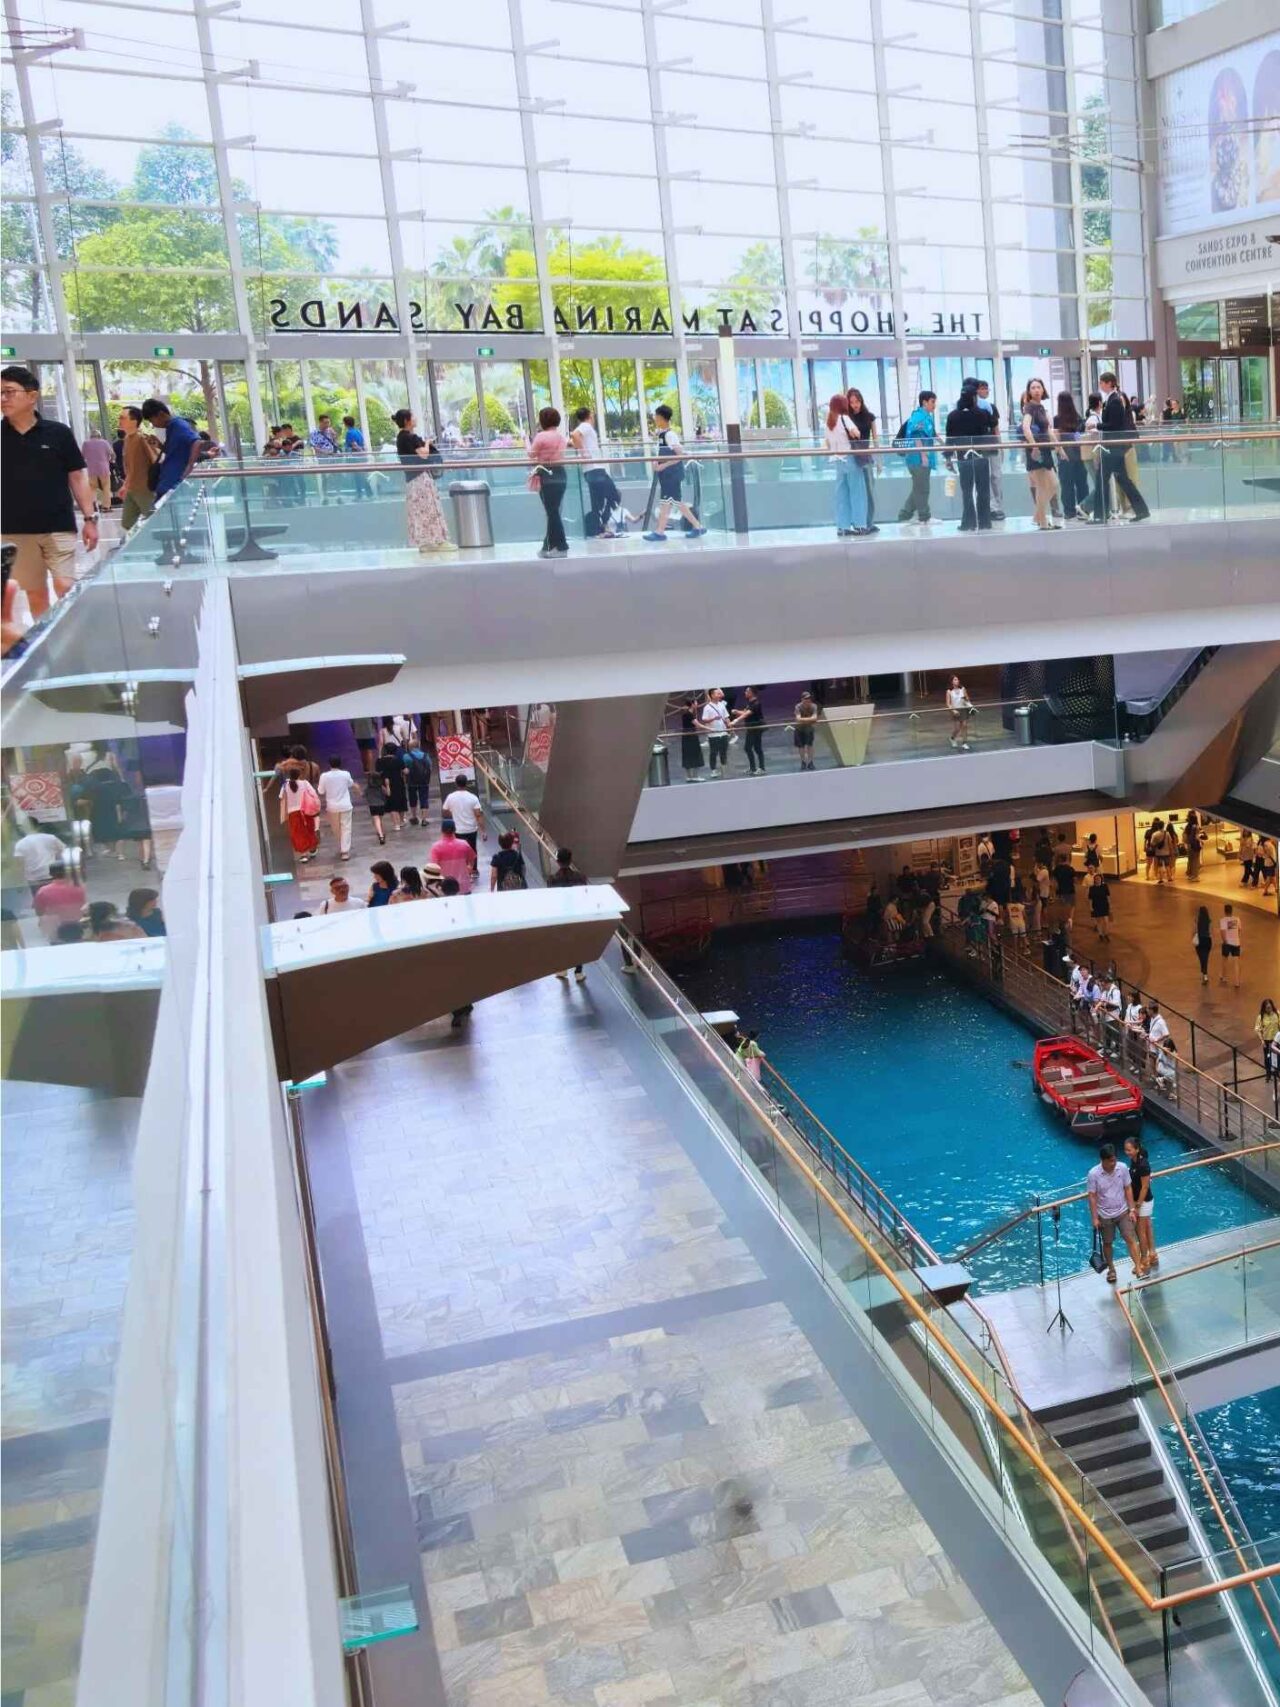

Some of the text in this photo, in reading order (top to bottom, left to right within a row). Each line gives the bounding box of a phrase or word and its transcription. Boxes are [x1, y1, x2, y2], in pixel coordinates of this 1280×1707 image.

[1198, 239, 1224, 254] SANDS
[1225, 234, 1248, 249] EXPO
[1185, 245, 1272, 273] CONVENTION CENTRE
